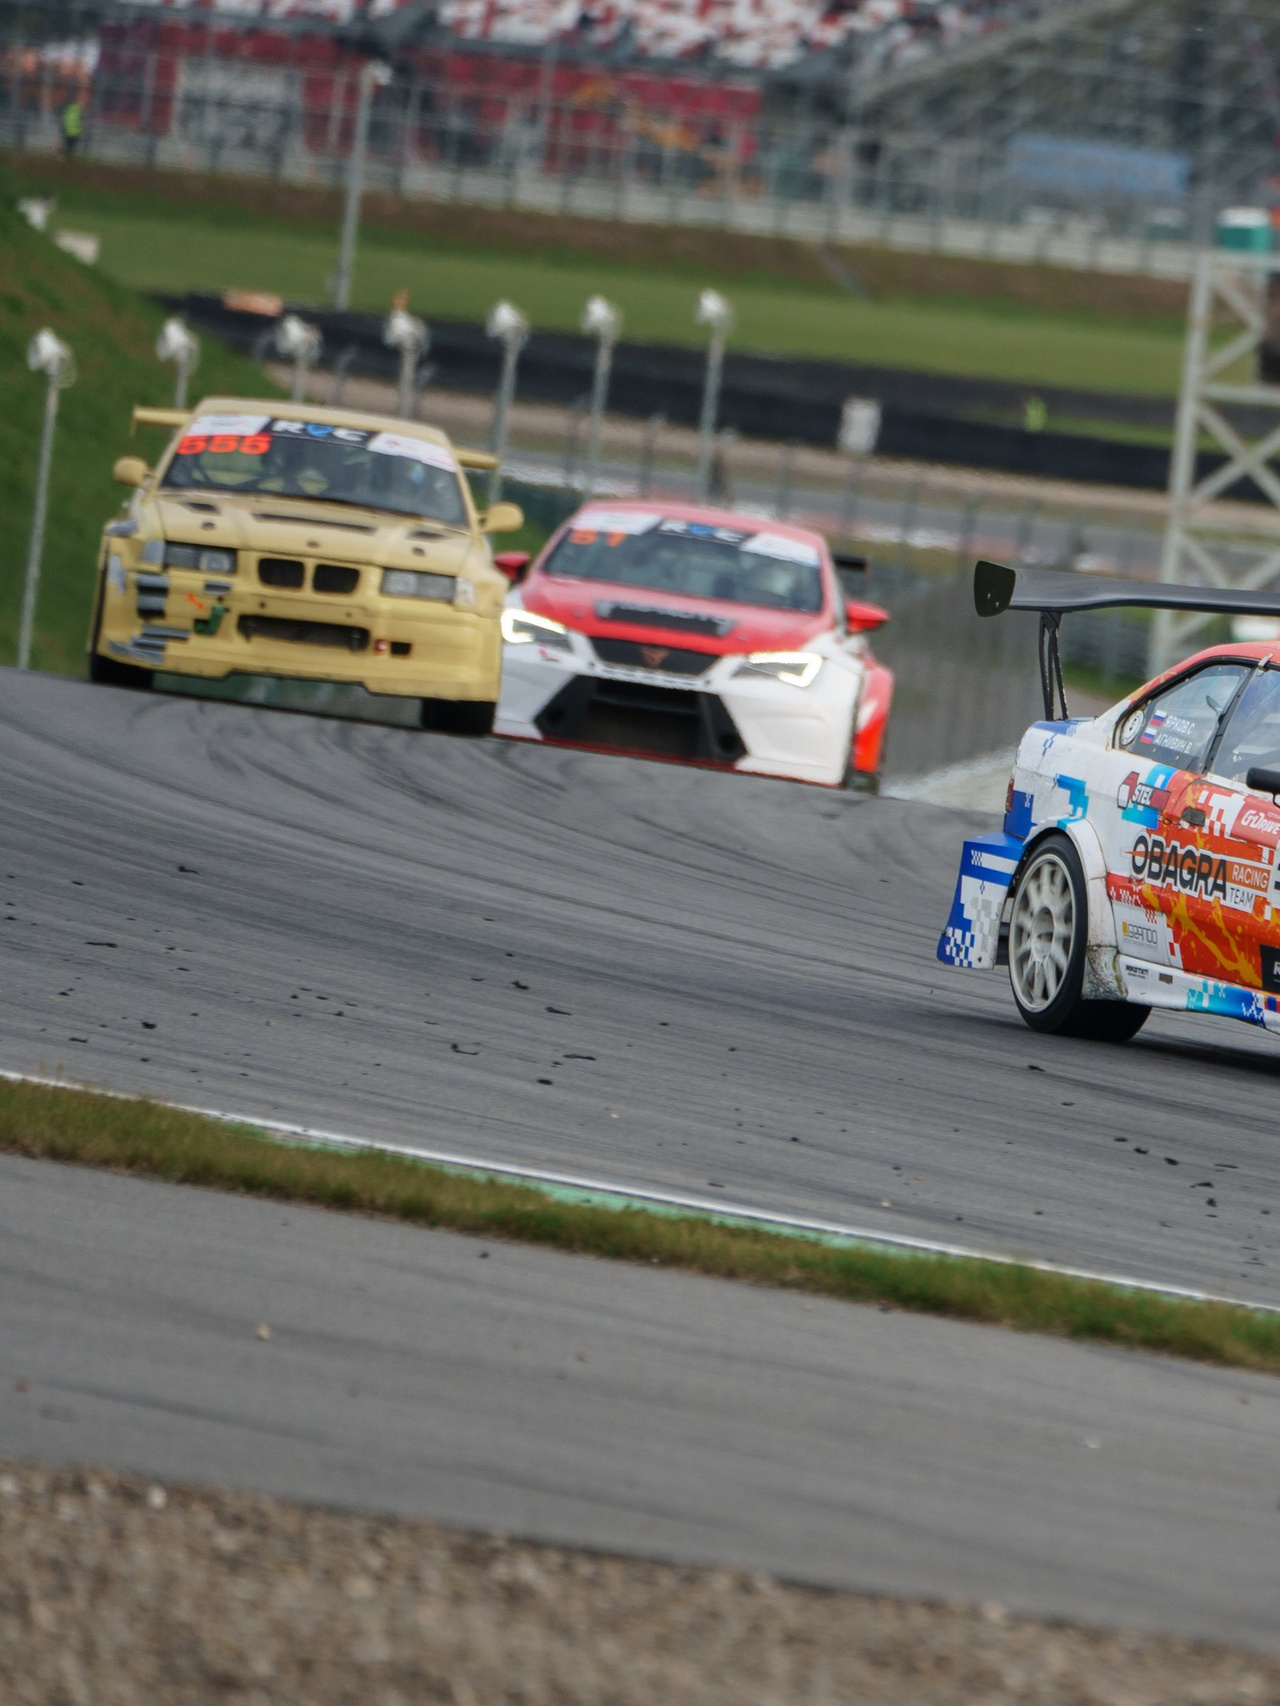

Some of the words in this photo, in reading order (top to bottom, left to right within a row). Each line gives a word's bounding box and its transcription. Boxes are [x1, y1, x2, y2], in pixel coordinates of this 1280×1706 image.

[1131, 834, 1228, 900] OBAGRA
[1231, 864, 1269, 890] RACING
[1229, 886, 1254, 909] TEAM
